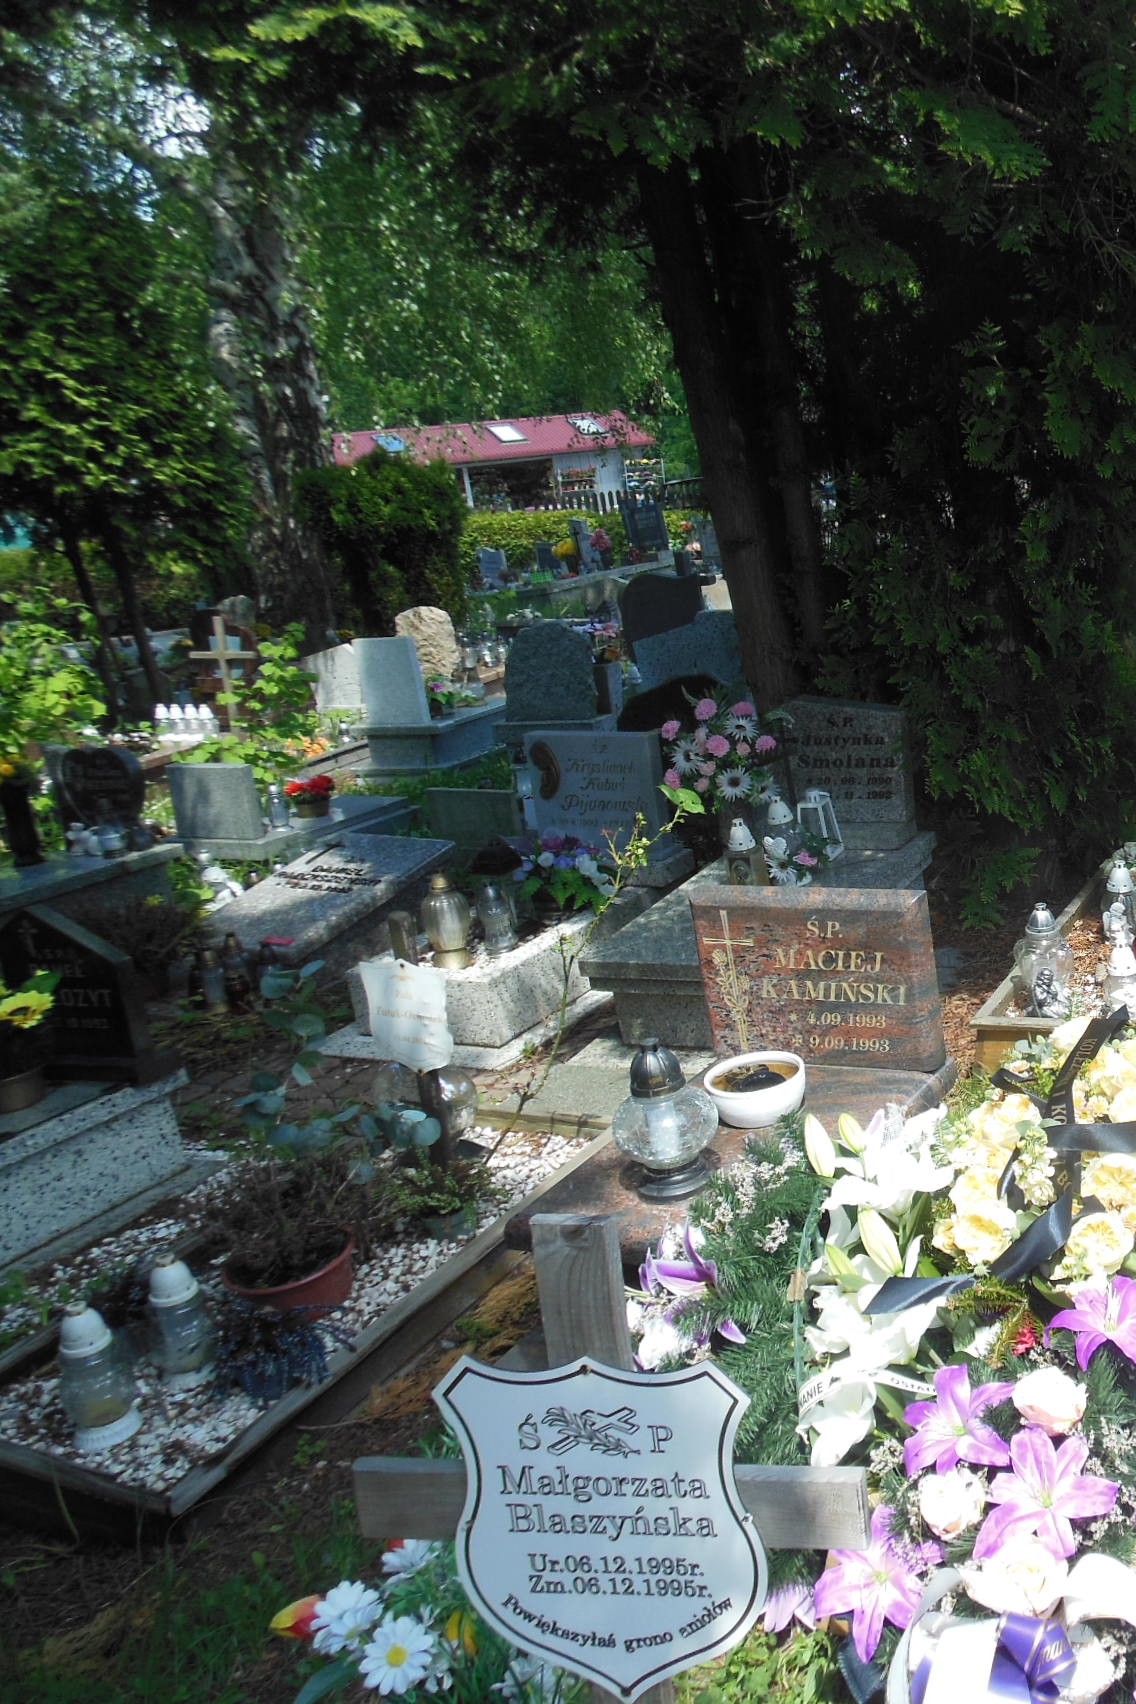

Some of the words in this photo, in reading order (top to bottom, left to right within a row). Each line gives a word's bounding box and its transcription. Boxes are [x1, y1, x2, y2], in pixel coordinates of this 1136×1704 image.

[774, 948, 884, 974] MACIEJ
[761, 976, 908, 1006] KAMIŃSKI
[807, 1011, 886, 1028] 4.09.1993
[518, 1414, 541, 1450] Ś
[648, 1424, 673, 1453] P
[497, 1465, 711, 1503] Małgorzata
[506, 1503, 719, 1541] Blaszyńska
[502, 1593, 617, 1649] Powiększyłaś
[623, 1630, 674, 1653] grono
[679, 1597, 733, 1638] aniołów
